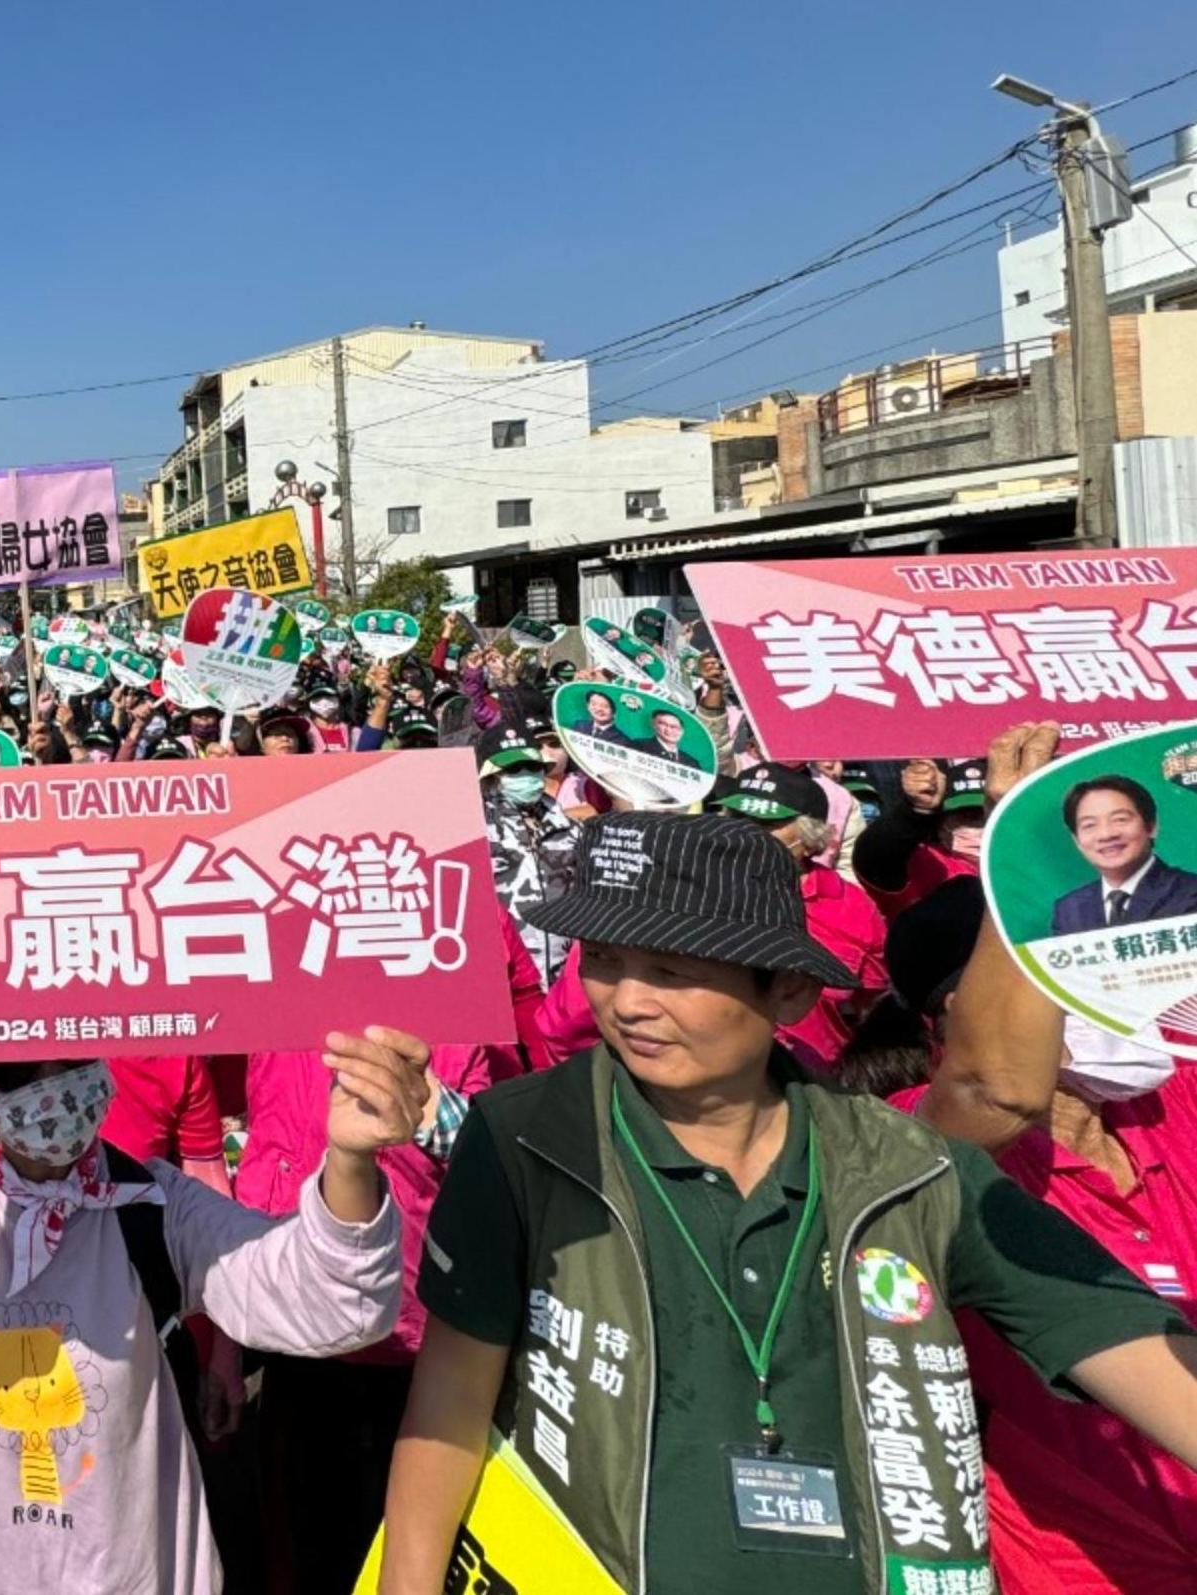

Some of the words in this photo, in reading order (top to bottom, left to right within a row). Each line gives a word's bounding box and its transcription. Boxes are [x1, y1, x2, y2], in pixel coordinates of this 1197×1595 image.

[152, 543, 301, 612] 天使之音協會
[896, 567, 1010, 591] TEAM
[1011, 559, 1173, 587] TAIWAN
[49, 773, 229, 820] TAIWAN
[54, 1016, 123, 1041] 挺台灣
[128, 1013, 197, 1037] 顧屏南
[589, 1321, 630, 1397] 特助
